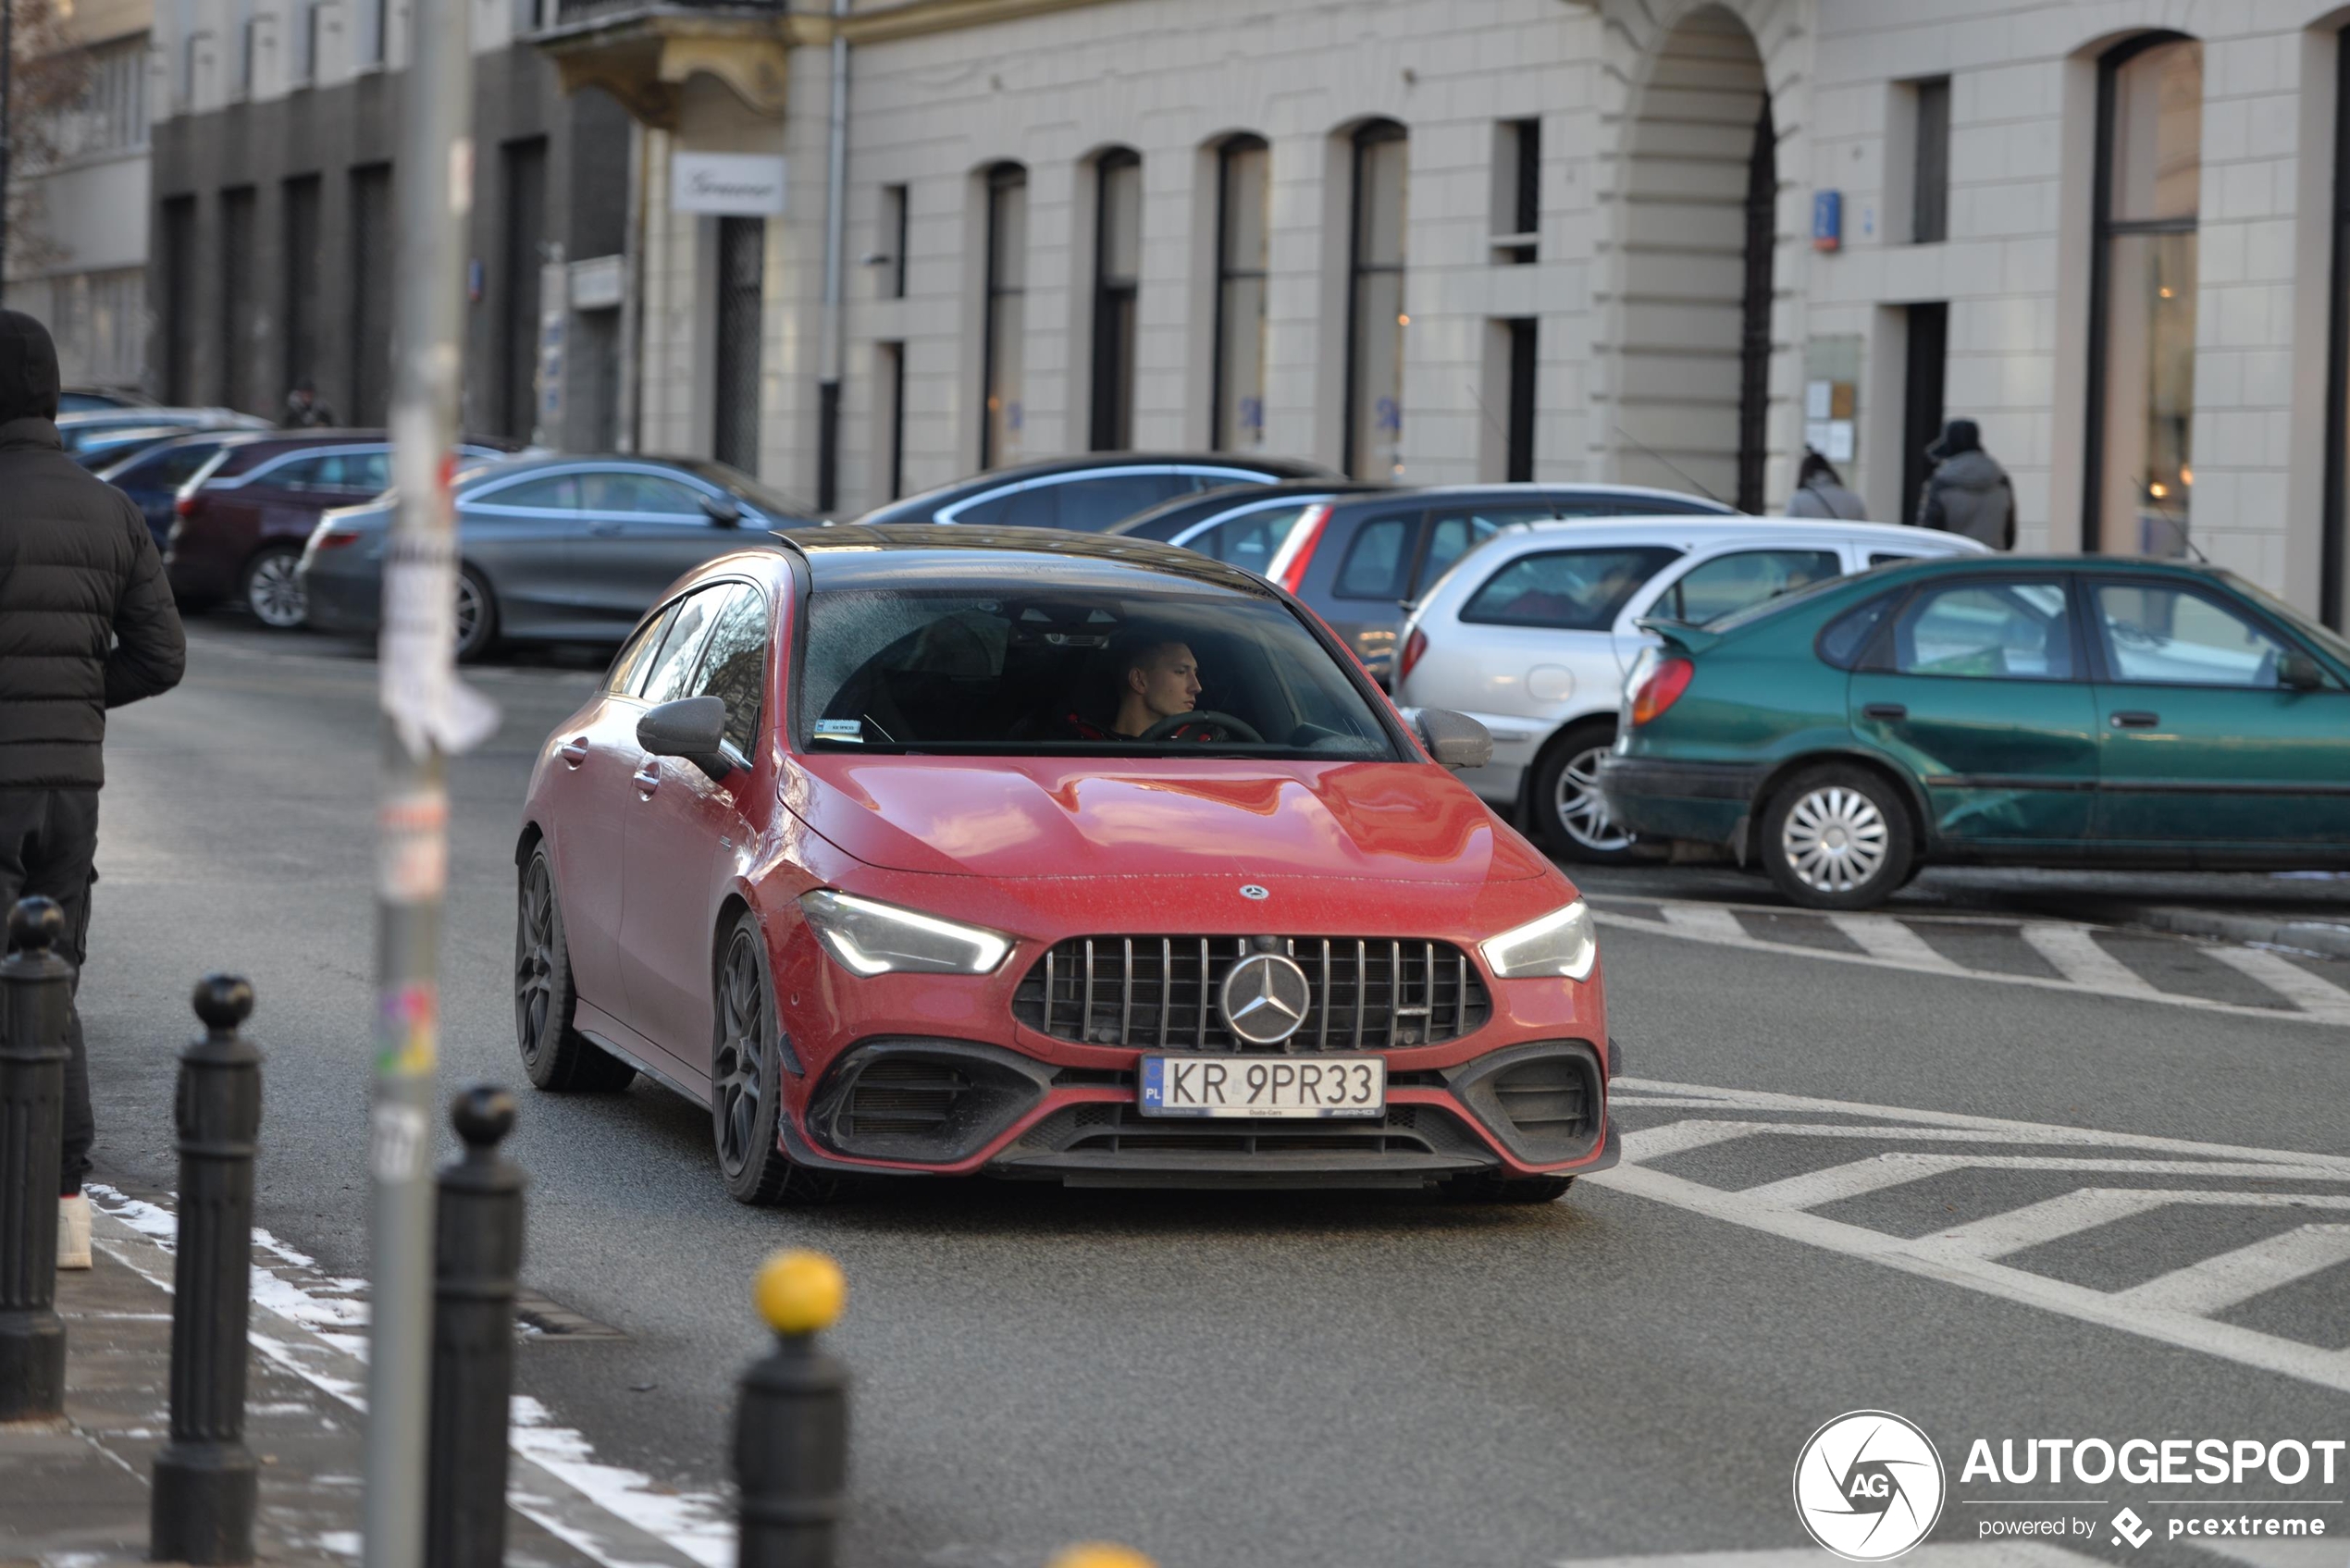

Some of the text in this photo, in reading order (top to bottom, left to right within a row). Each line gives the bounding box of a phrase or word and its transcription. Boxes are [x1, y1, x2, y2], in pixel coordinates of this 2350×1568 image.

[1145, 1088, 1161, 1100] PL
[1173, 1063, 1372, 1105] KR 9PR33
